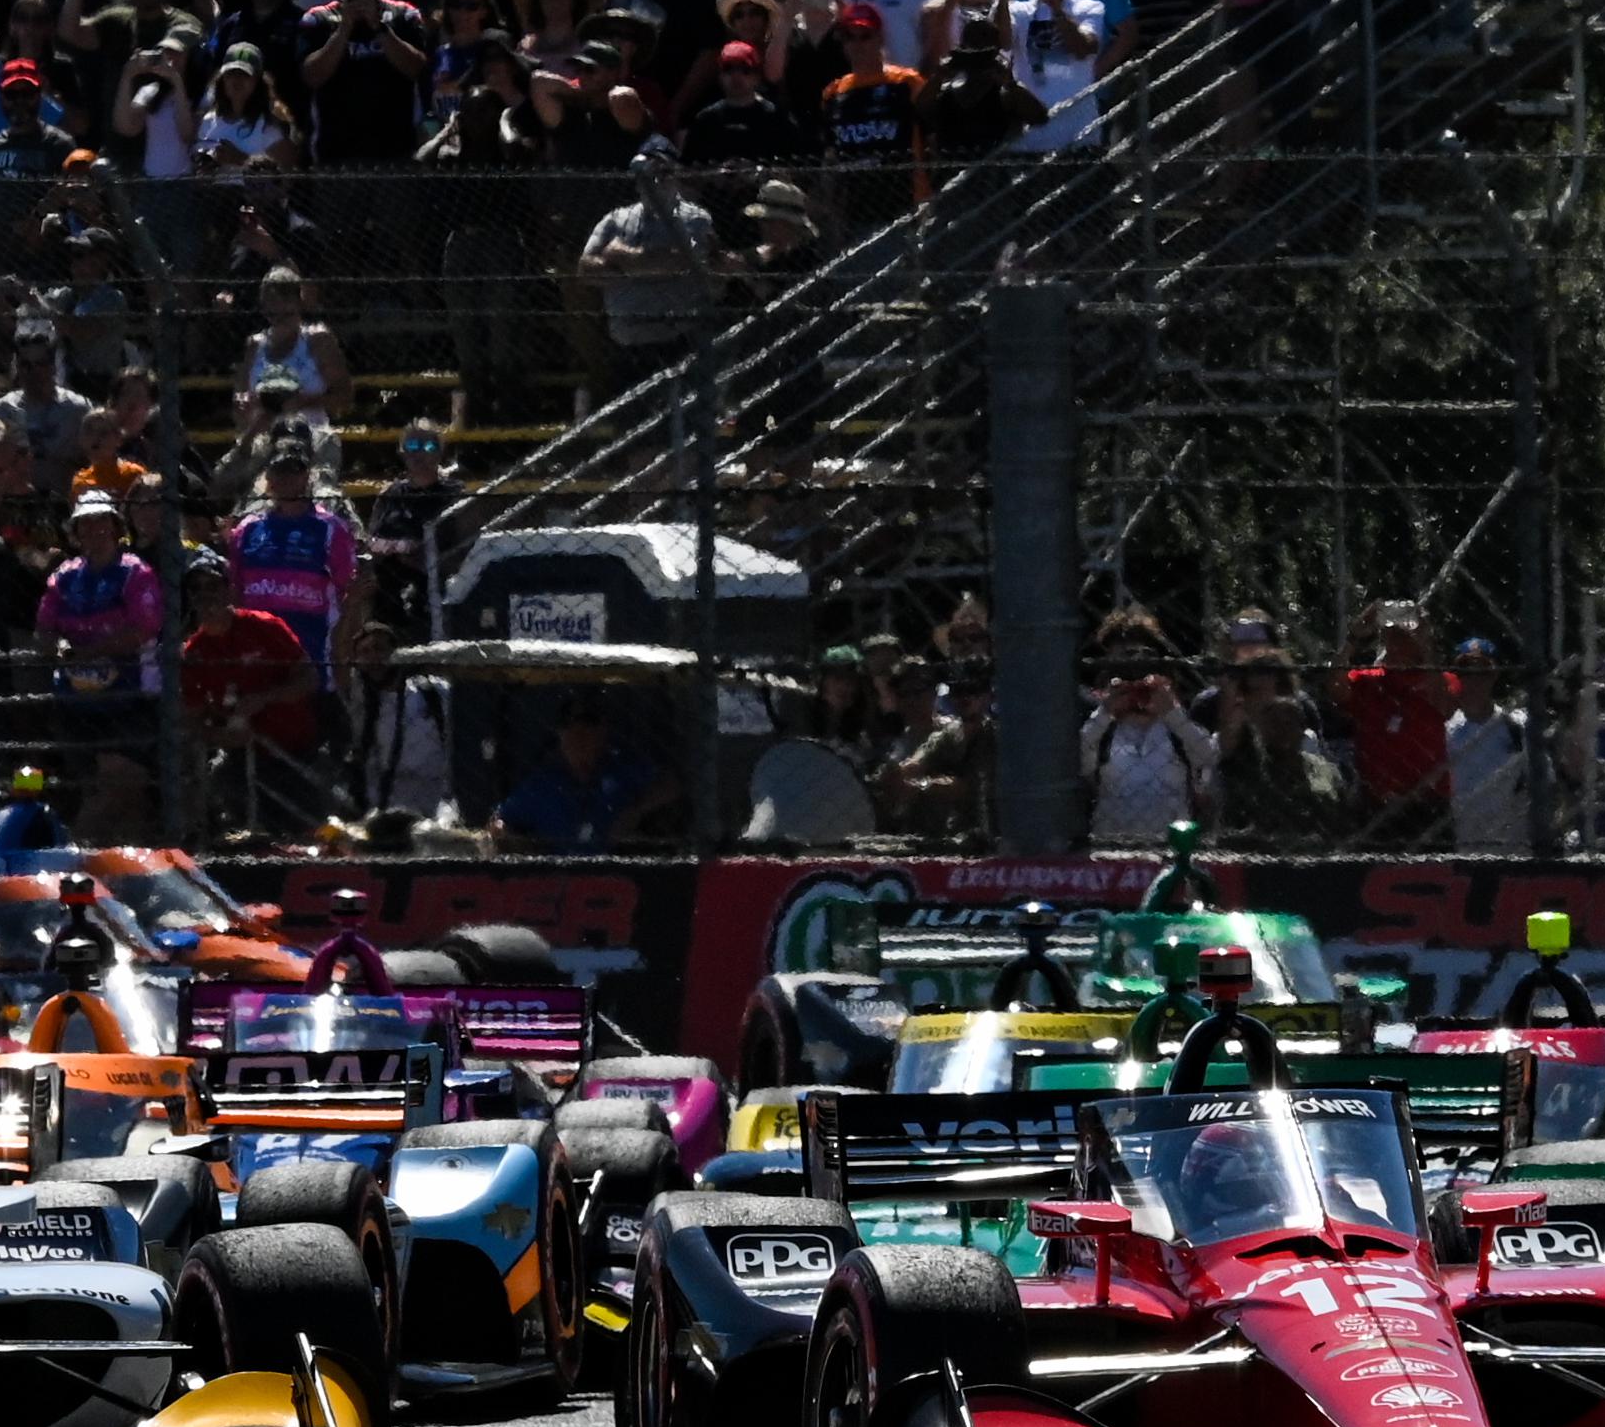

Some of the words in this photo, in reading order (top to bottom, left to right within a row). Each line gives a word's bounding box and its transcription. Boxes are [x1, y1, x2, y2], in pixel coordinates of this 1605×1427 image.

[1188, 1102, 1252, 1122] WILL
[1290, 1096, 1377, 1120] OWER
[902, 1106, 1079, 1154] veri
[7, 1214, 92, 1231] SHIELD
[733, 1239, 830, 1278] PPG
[1499, 1227, 1596, 1263] PPG
[1280, 1274, 1437, 1321] 12
